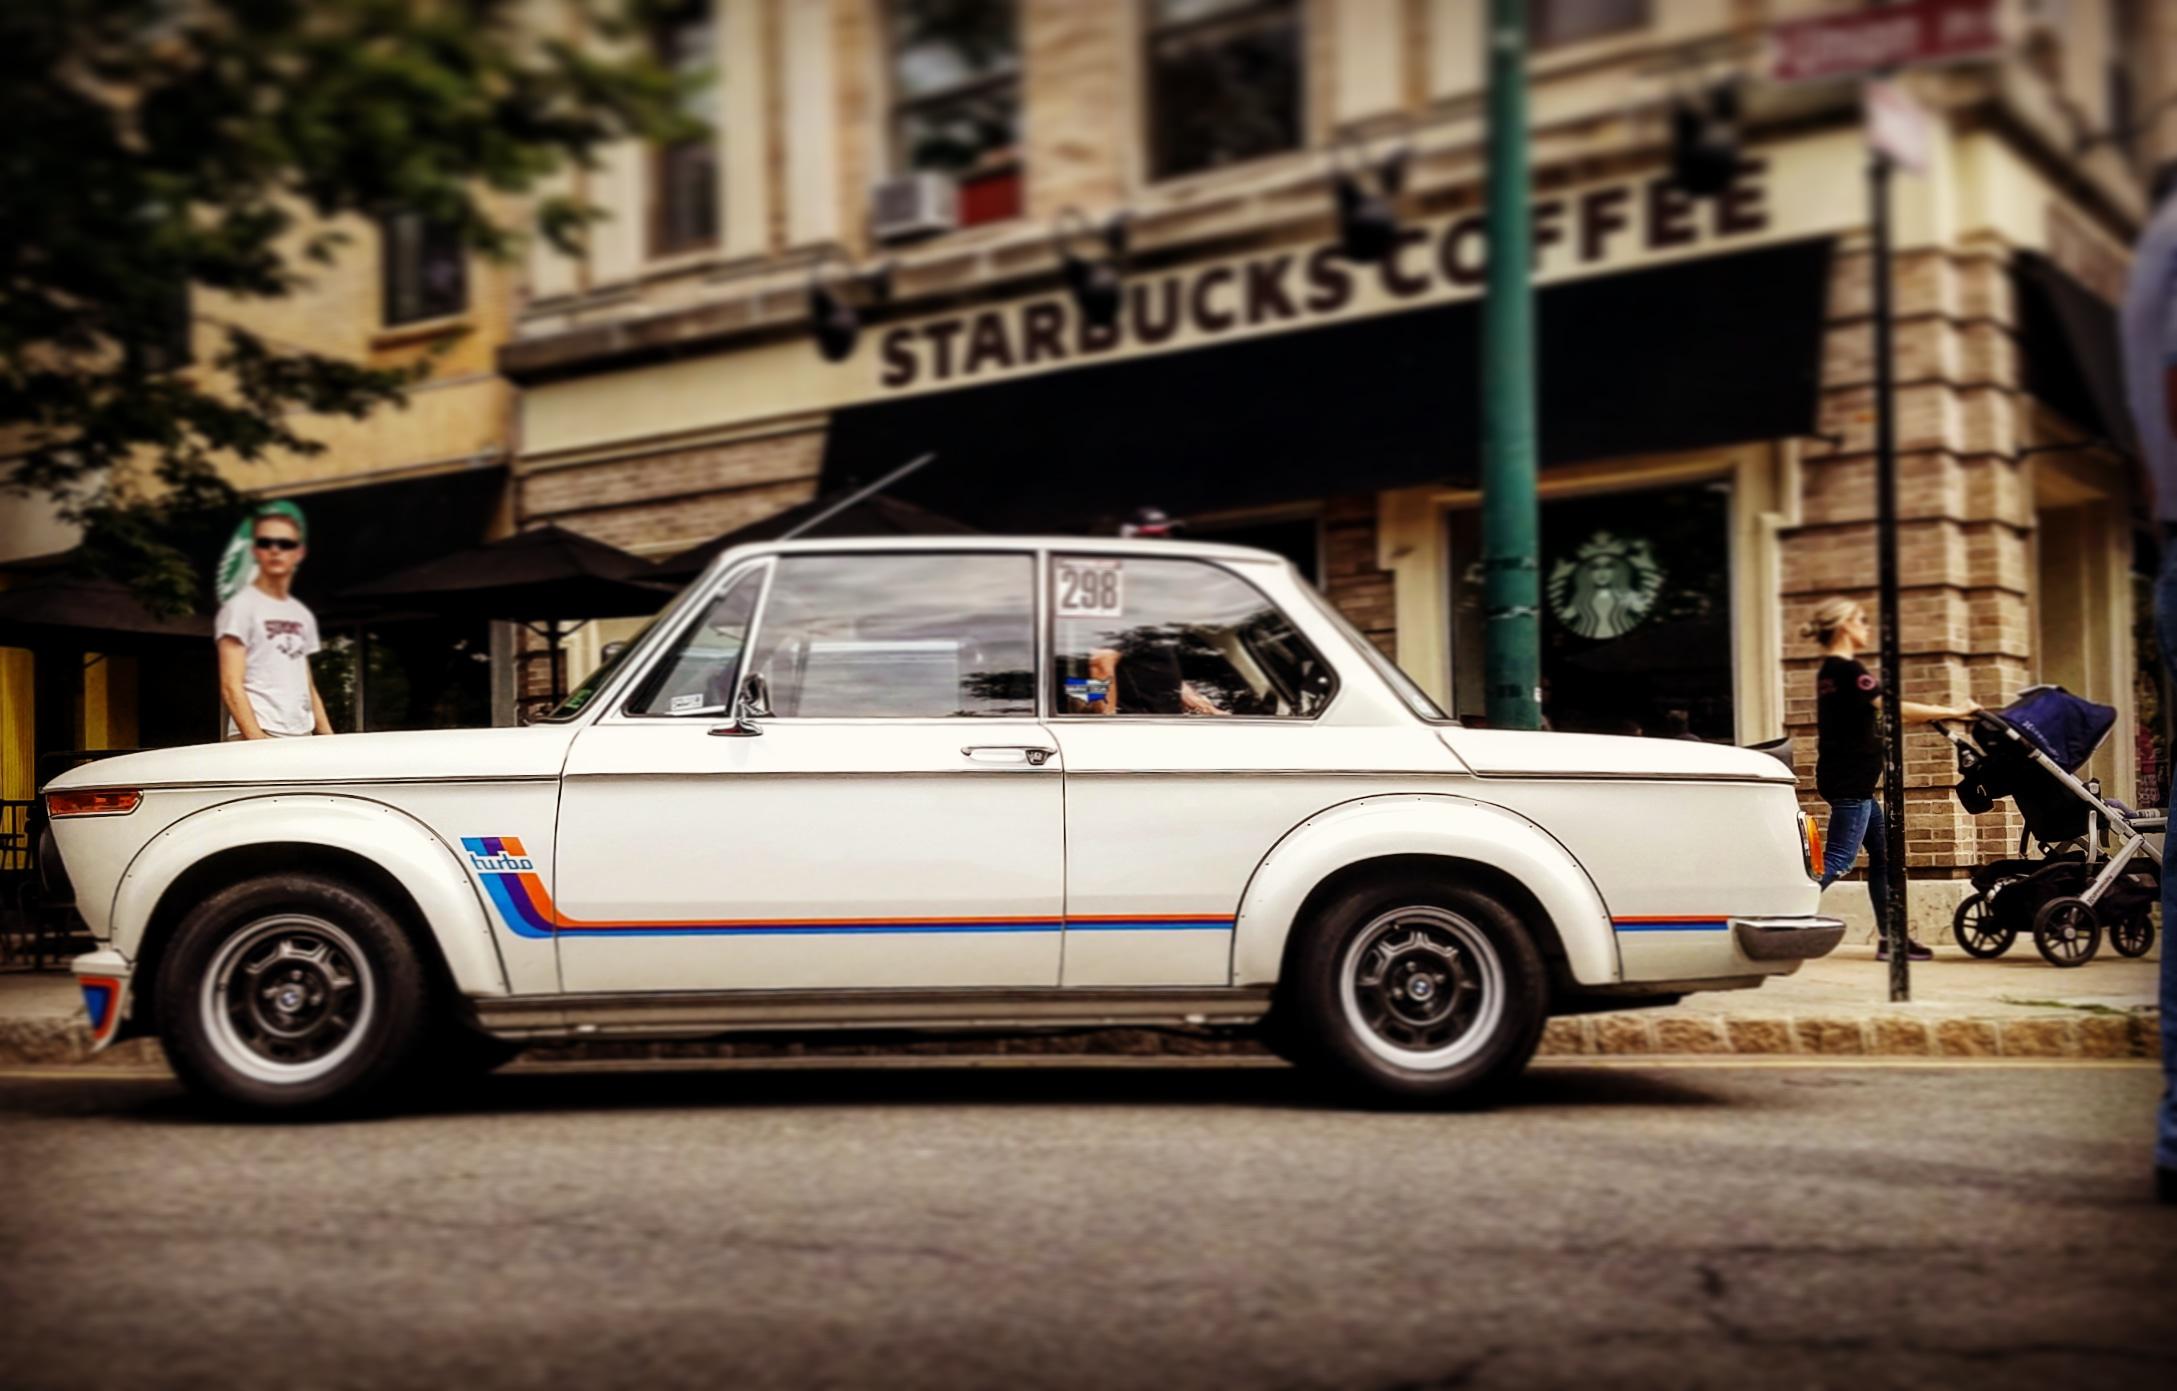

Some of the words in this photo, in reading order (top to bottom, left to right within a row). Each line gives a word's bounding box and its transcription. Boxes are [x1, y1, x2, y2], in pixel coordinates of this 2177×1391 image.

[880, 244, 1355, 388] STARBUCKS
[1061, 568, 1117, 609] 298
[469, 853, 534, 870] turbo
